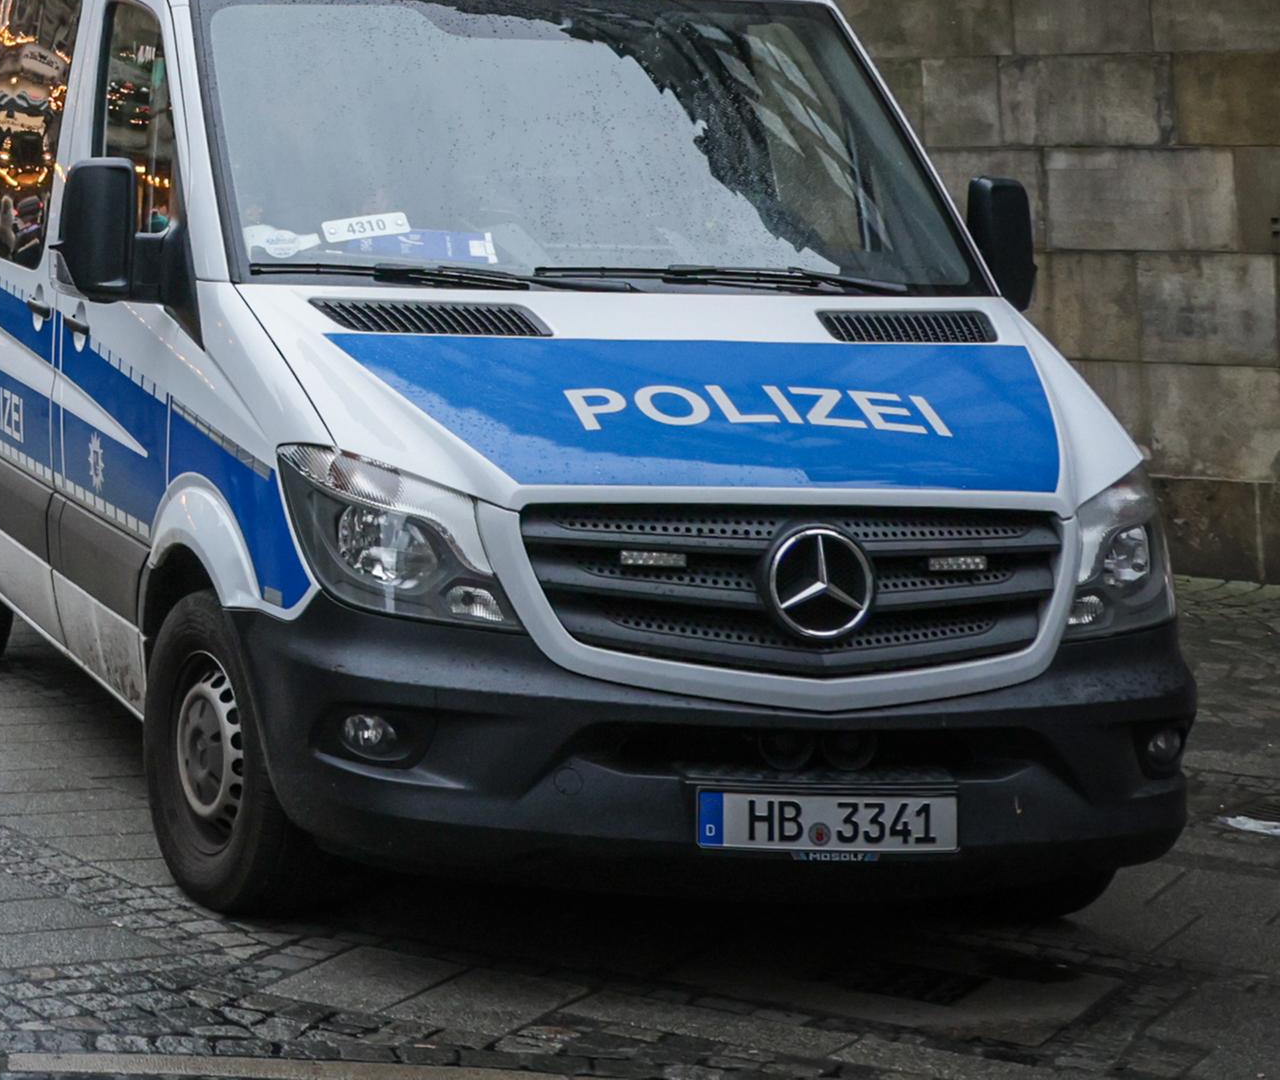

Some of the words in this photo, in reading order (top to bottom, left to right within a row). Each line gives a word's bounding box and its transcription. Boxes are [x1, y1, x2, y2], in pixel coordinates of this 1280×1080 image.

[346, 218, 387, 236] 4310
[563, 384, 953, 438] POLIZEI
[705, 824, 716, 836] D
[748, 799, 804, 842] HB
[836, 802, 937, 845] 3341
[809, 851, 864, 862] MOSOLF
